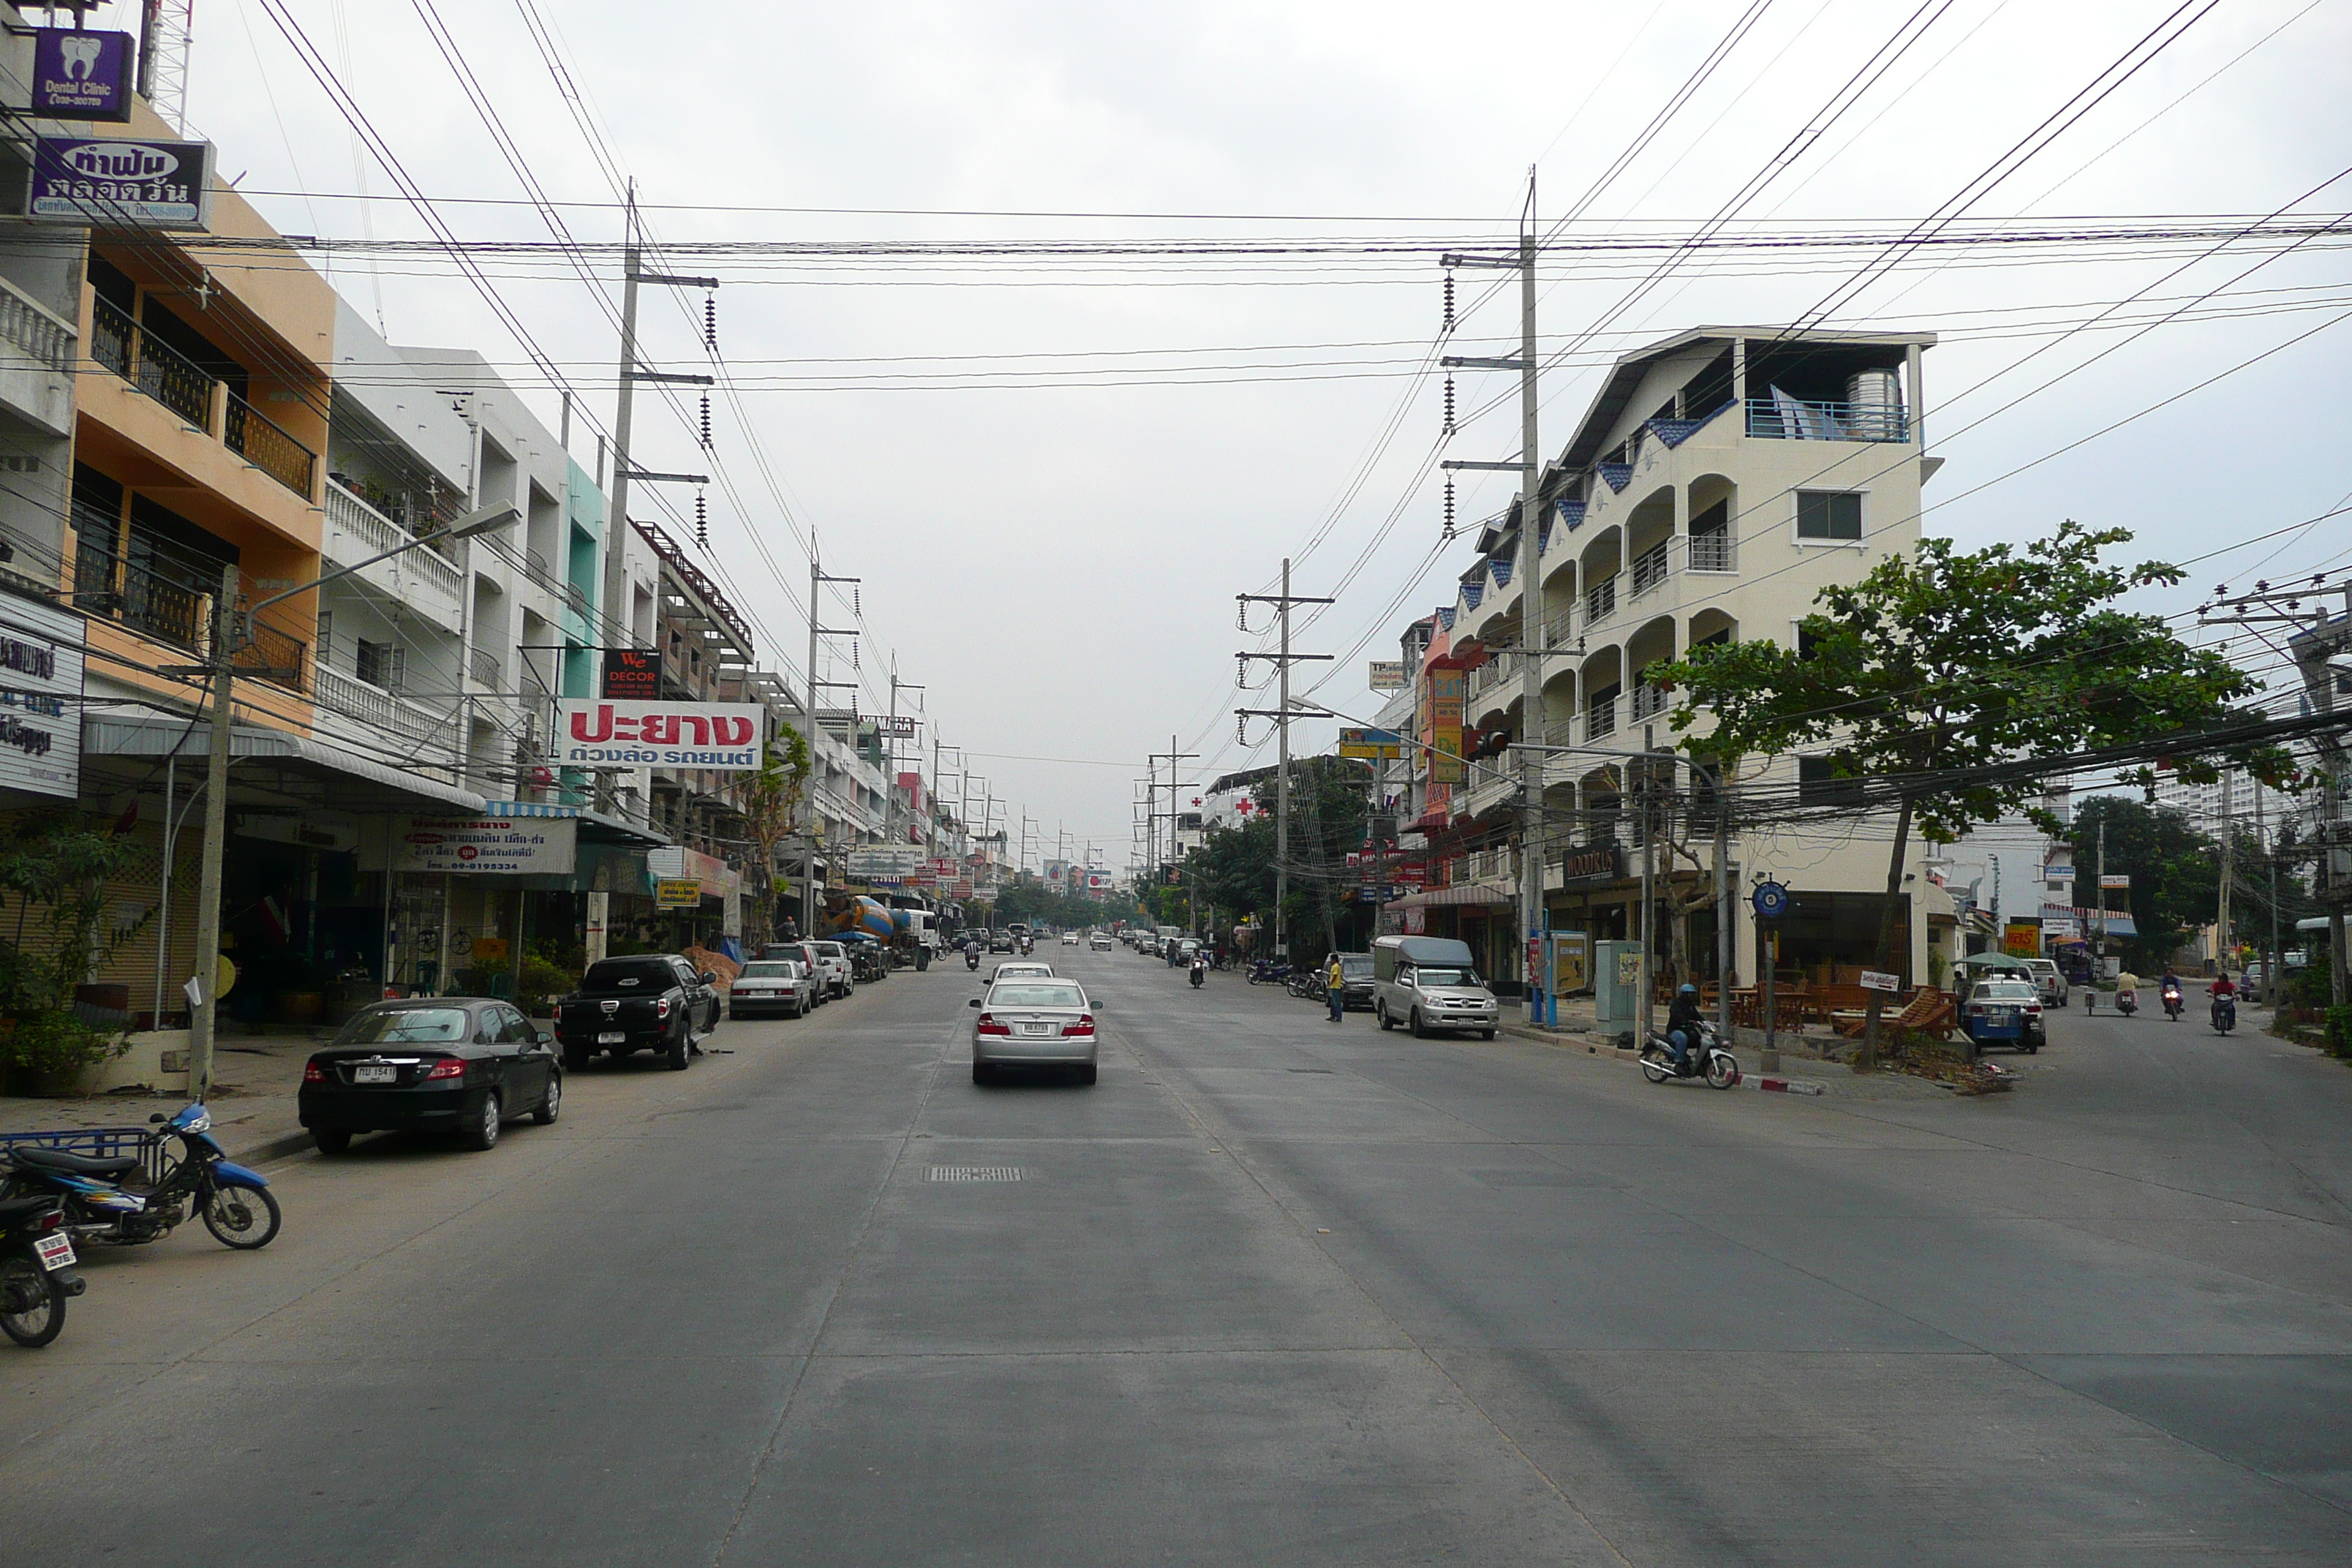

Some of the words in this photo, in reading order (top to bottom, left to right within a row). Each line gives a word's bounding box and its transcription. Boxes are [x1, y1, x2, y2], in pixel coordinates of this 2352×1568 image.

[45, 80, 78, 94] Dental
[82, 82, 111, 96] Clinic
[75, 146, 166, 176] ทำฟัน
[620, 652, 647, 668] We
[610, 668, 656, 682] DÉCOR
[570, 704, 755, 746] ปะยาง
[570, 745, 658, 763] ถ่วงล้อ
[664, 748, 757, 765] รถยนต์
[374, 1068, 393, 1076] 1541
[48, 1254, 71, 1267] 576
